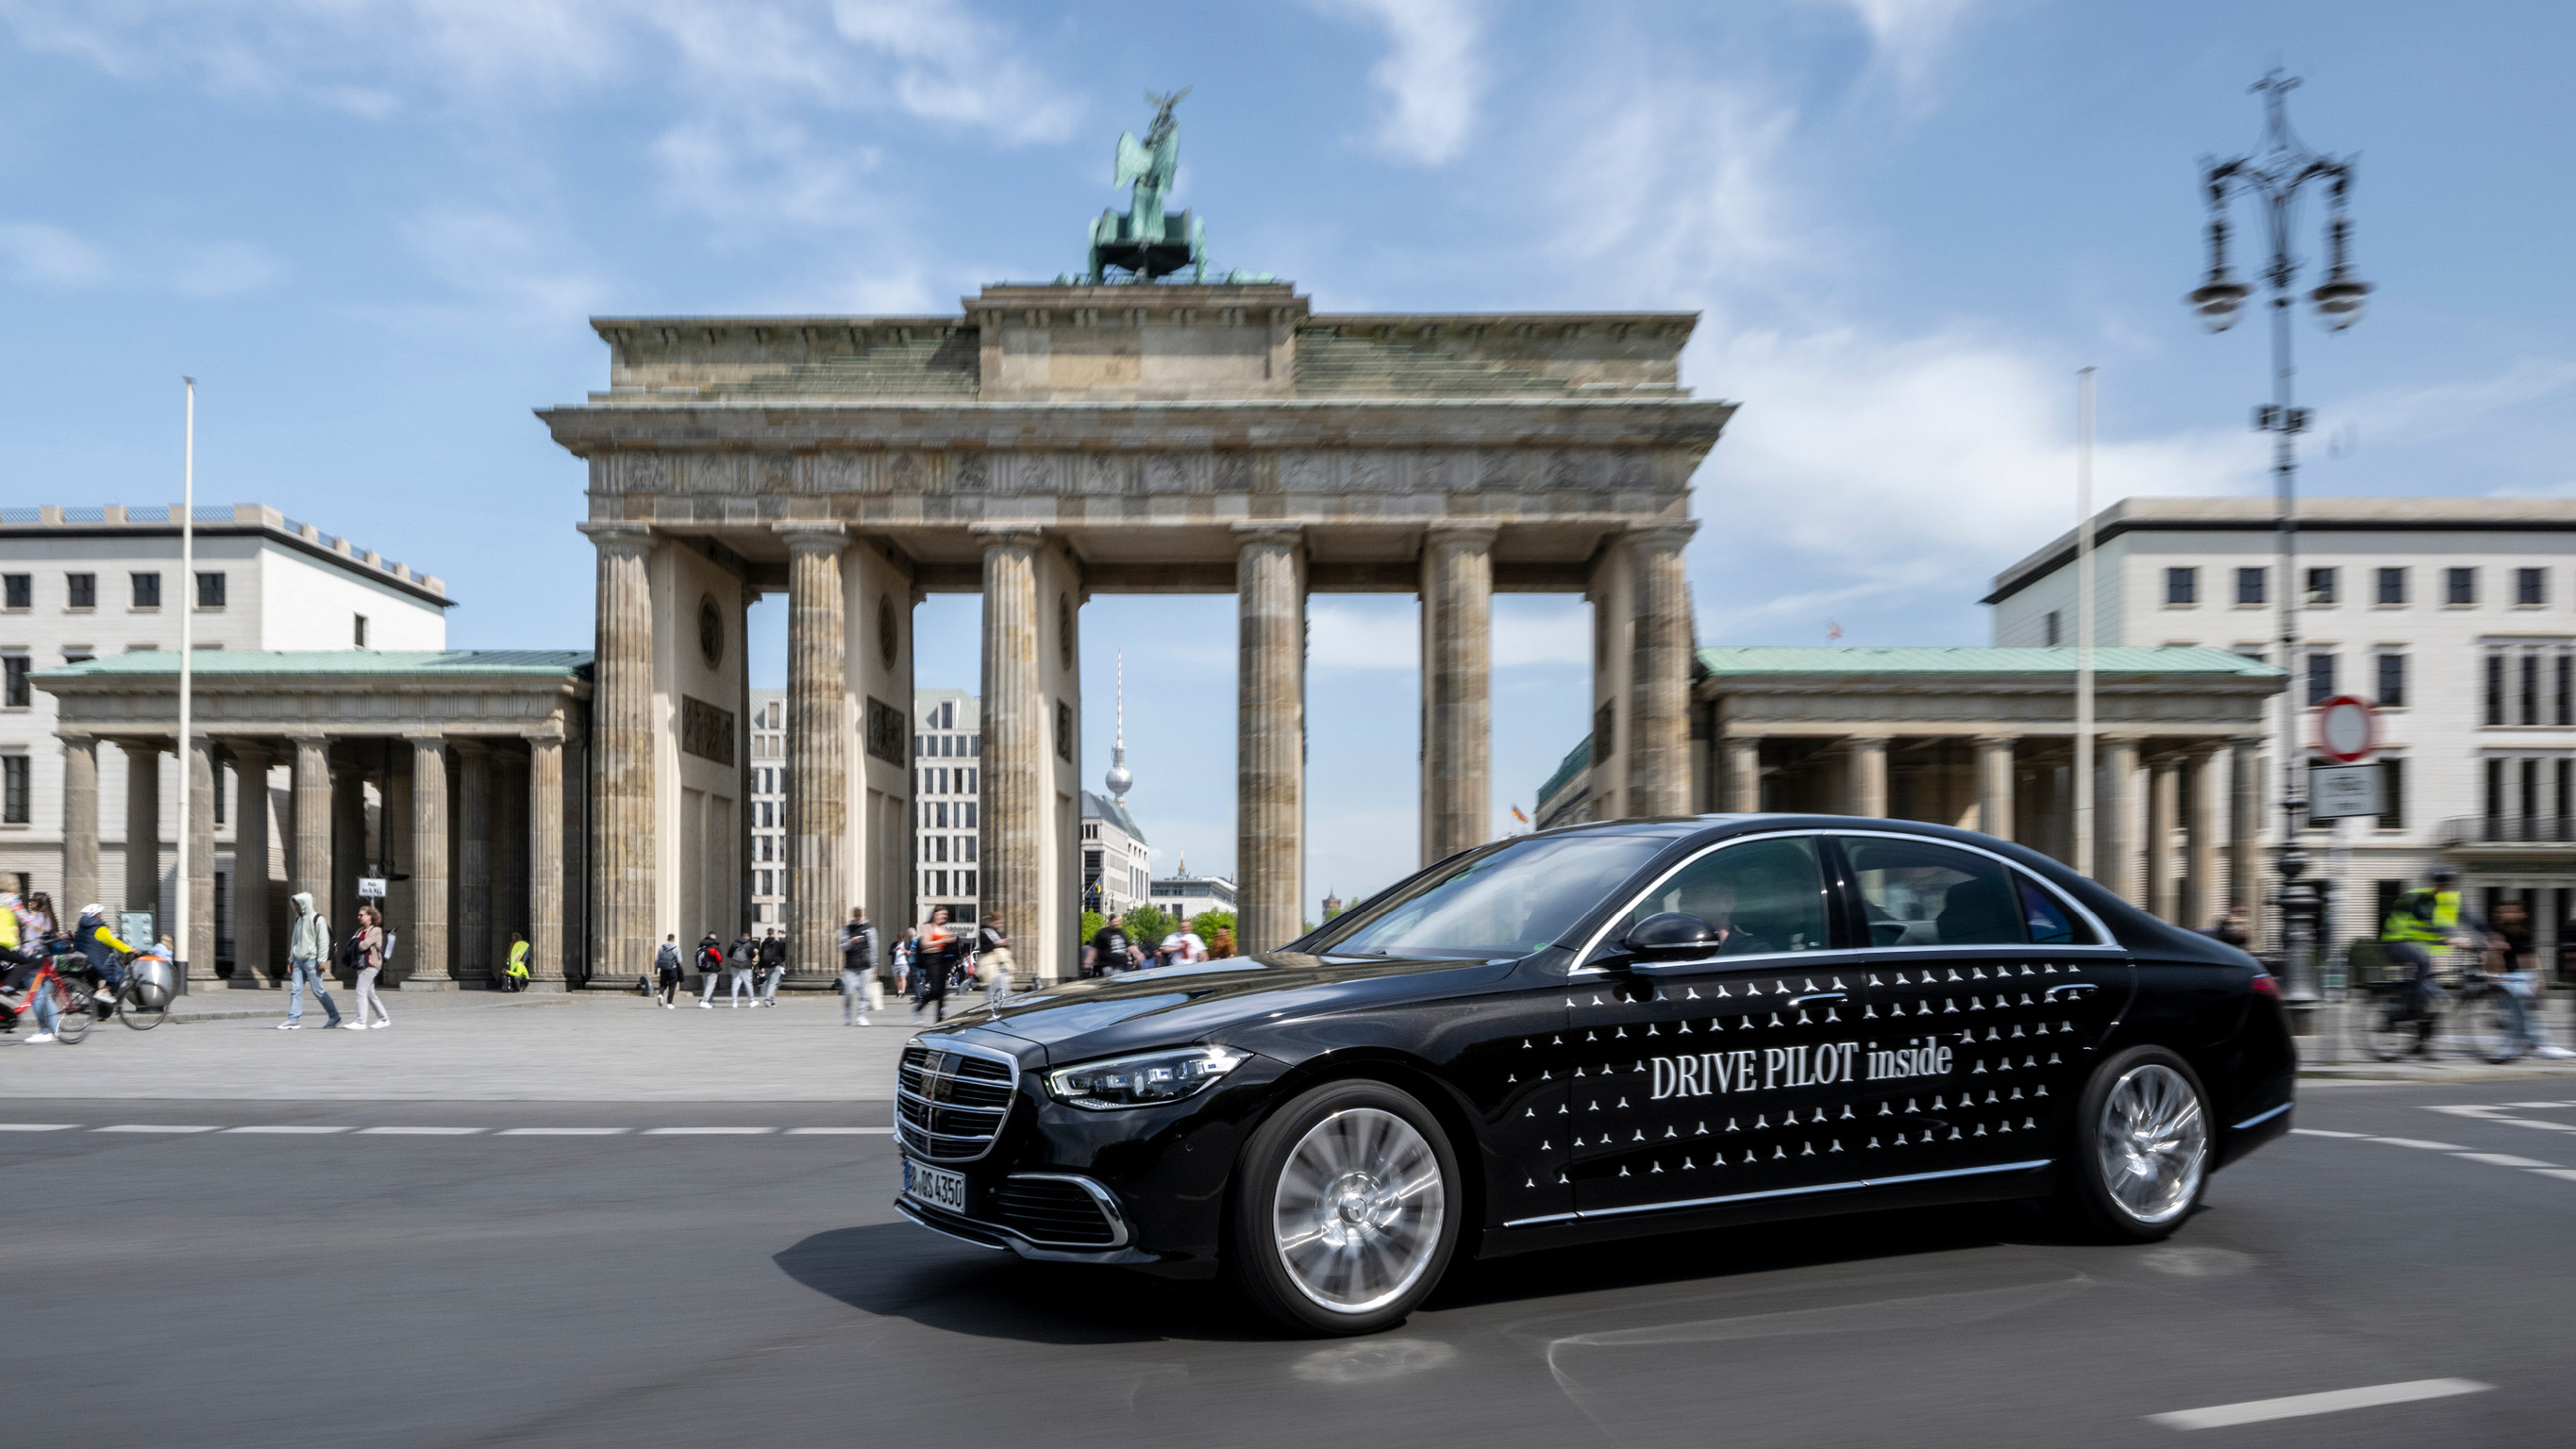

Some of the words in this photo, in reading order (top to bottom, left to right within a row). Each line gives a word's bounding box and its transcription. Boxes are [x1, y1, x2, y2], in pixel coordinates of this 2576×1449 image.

[1650, 1050, 1757, 1100] DRIVE
[1764, 1041, 1859, 1090] PILOT
[1865, 1036, 1953, 1081] inside
[935, 1174, 962, 1208] 4350
